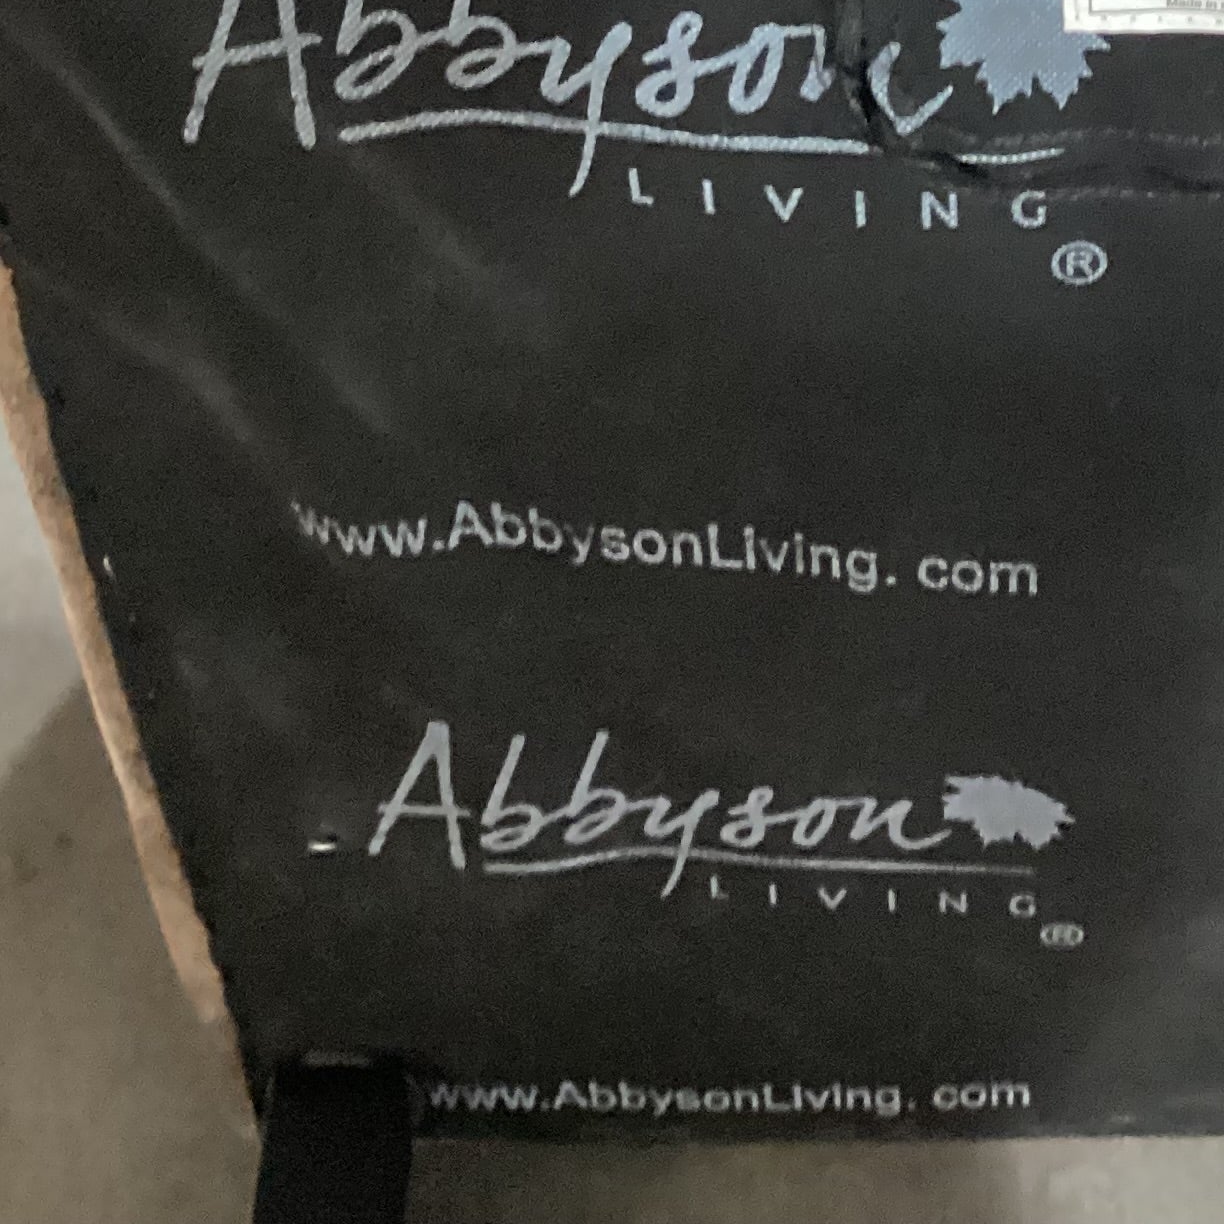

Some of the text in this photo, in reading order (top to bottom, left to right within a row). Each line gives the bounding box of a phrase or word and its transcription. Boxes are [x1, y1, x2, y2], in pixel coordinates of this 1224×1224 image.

[630, 168, 1048, 229] LIVING
[917, 554, 1037, 596] com
[368, 720, 952, 898] Abbyson
[710, 874, 1036, 916] LIVING
[933, 1081, 1030, 1111] com
